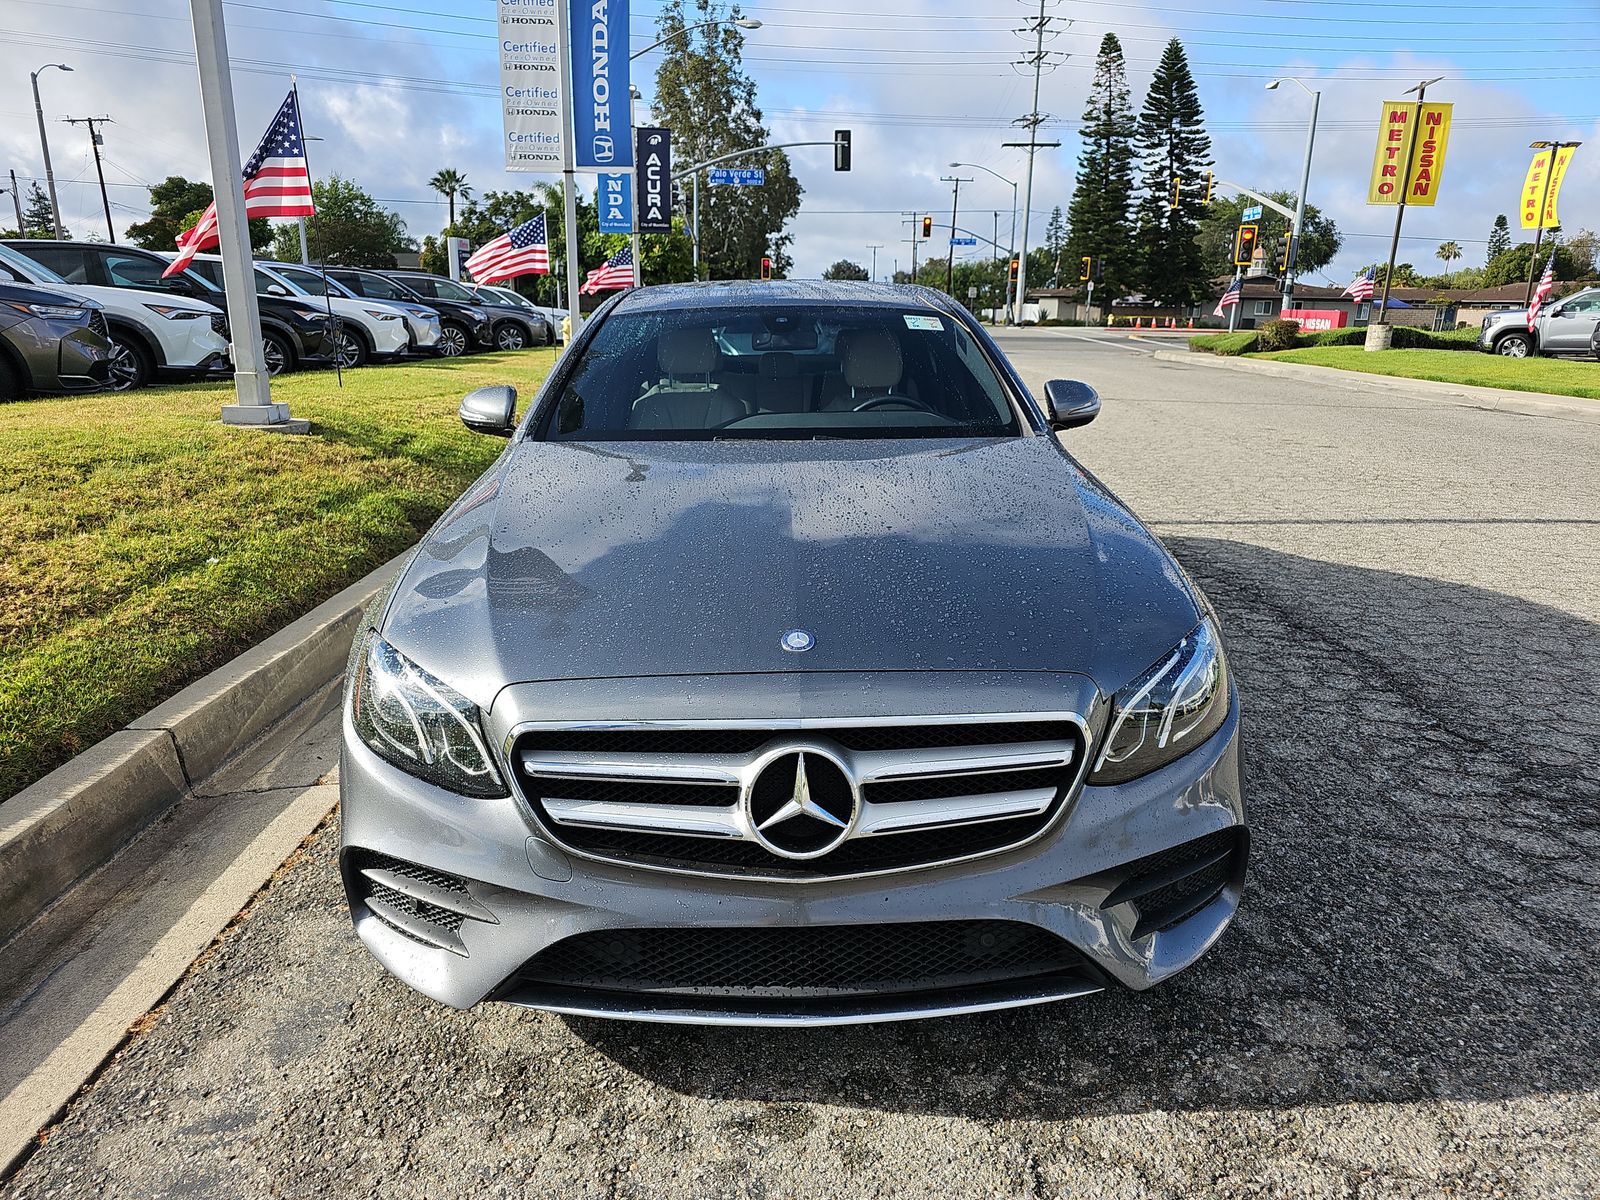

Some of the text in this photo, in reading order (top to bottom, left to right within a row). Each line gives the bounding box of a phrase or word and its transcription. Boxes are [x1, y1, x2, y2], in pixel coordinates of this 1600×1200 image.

[502, 7, 554, 15] Pre-Owned
[511, 17, 554, 25] HONDA
[503, 41, 556, 53] Certified
[504, 53, 556, 62] Pre-Owned
[592, 0, 610, 132] HONDA
[505, 86, 558, 98] Certified
[506, 99, 558, 107] Pre-Owned
[508, 131, 560, 143] Certified
[518, 153, 560, 161] HONDA
[1378, 111, 1407, 194] METRO
[1413, 112, 1442, 195] NISSAN
[710, 170, 762, 179] Palo Verde St
[646, 152, 662, 220] ACURA
[1525, 159, 1546, 221] METRO
[1546, 155, 1567, 220] NISSAN
[1305, 318, 1331, 330] NISSAN
